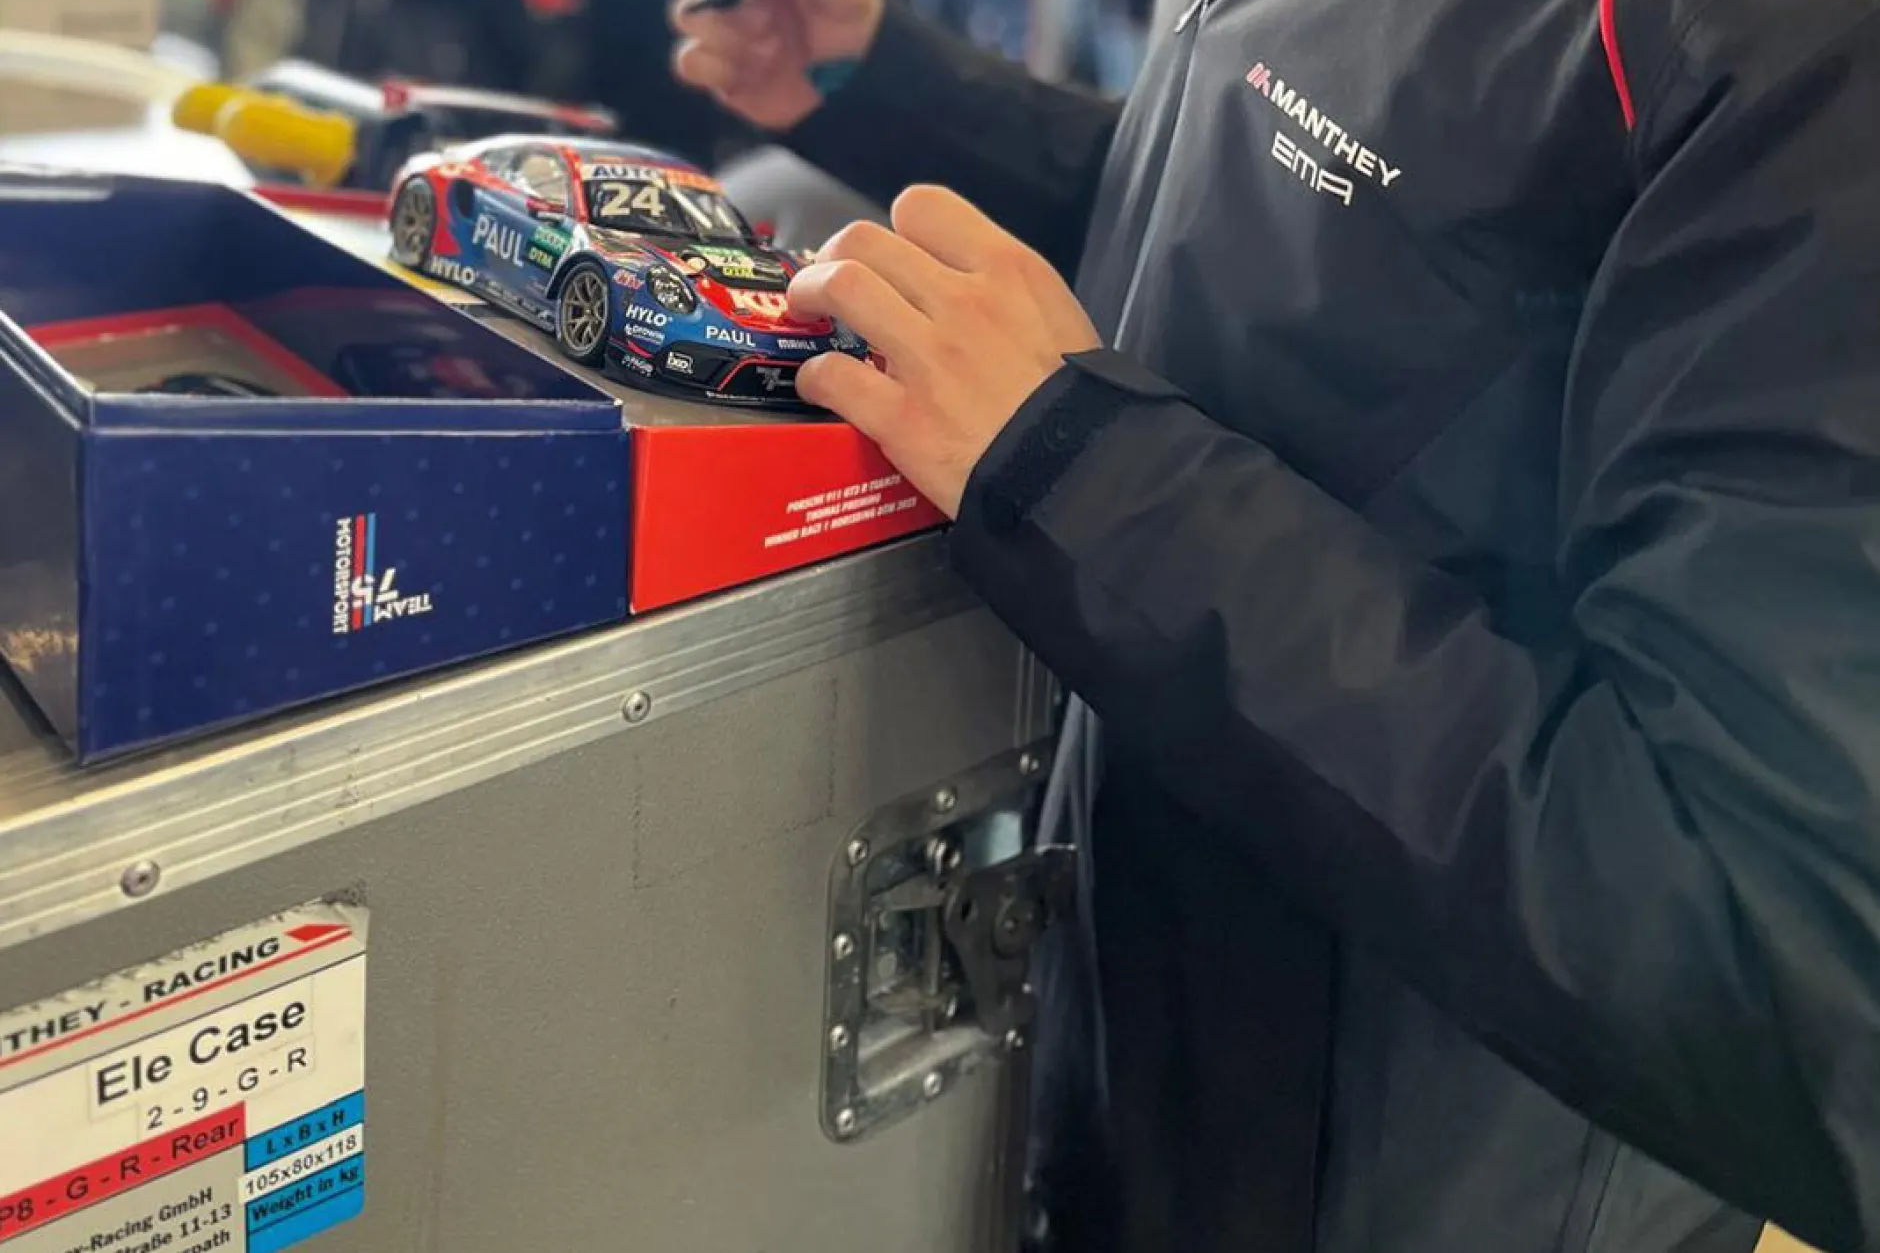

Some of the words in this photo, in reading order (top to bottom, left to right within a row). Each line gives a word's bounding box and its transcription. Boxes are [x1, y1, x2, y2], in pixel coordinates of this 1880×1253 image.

[1269, 78, 1402, 187] MANTHEY
[600, 181, 666, 217] 24
[471, 213, 525, 268] PAUL
[430, 255, 476, 285] HYLO
[625, 304, 668, 327] HYLO
[706, 325, 757, 347] PAUL
[332, 516, 353, 634] MOTORSPORT
[373, 592, 433, 623] TEAM
[0, 999, 107, 1058] THEY
[142, 936, 281, 1003] RACING
[96, 1054, 173, 1106] Ele
[188, 1001, 306, 1065] Case
[171, 1117, 239, 1159] Rear
[246, 1134, 358, 1196] 105x80x118
[158, 1186, 212, 1222] GmbH
[180, 1202, 232, 1238] 11-13
[251, 1183, 313, 1222] Weight
[318, 1177, 334, 1193] in
